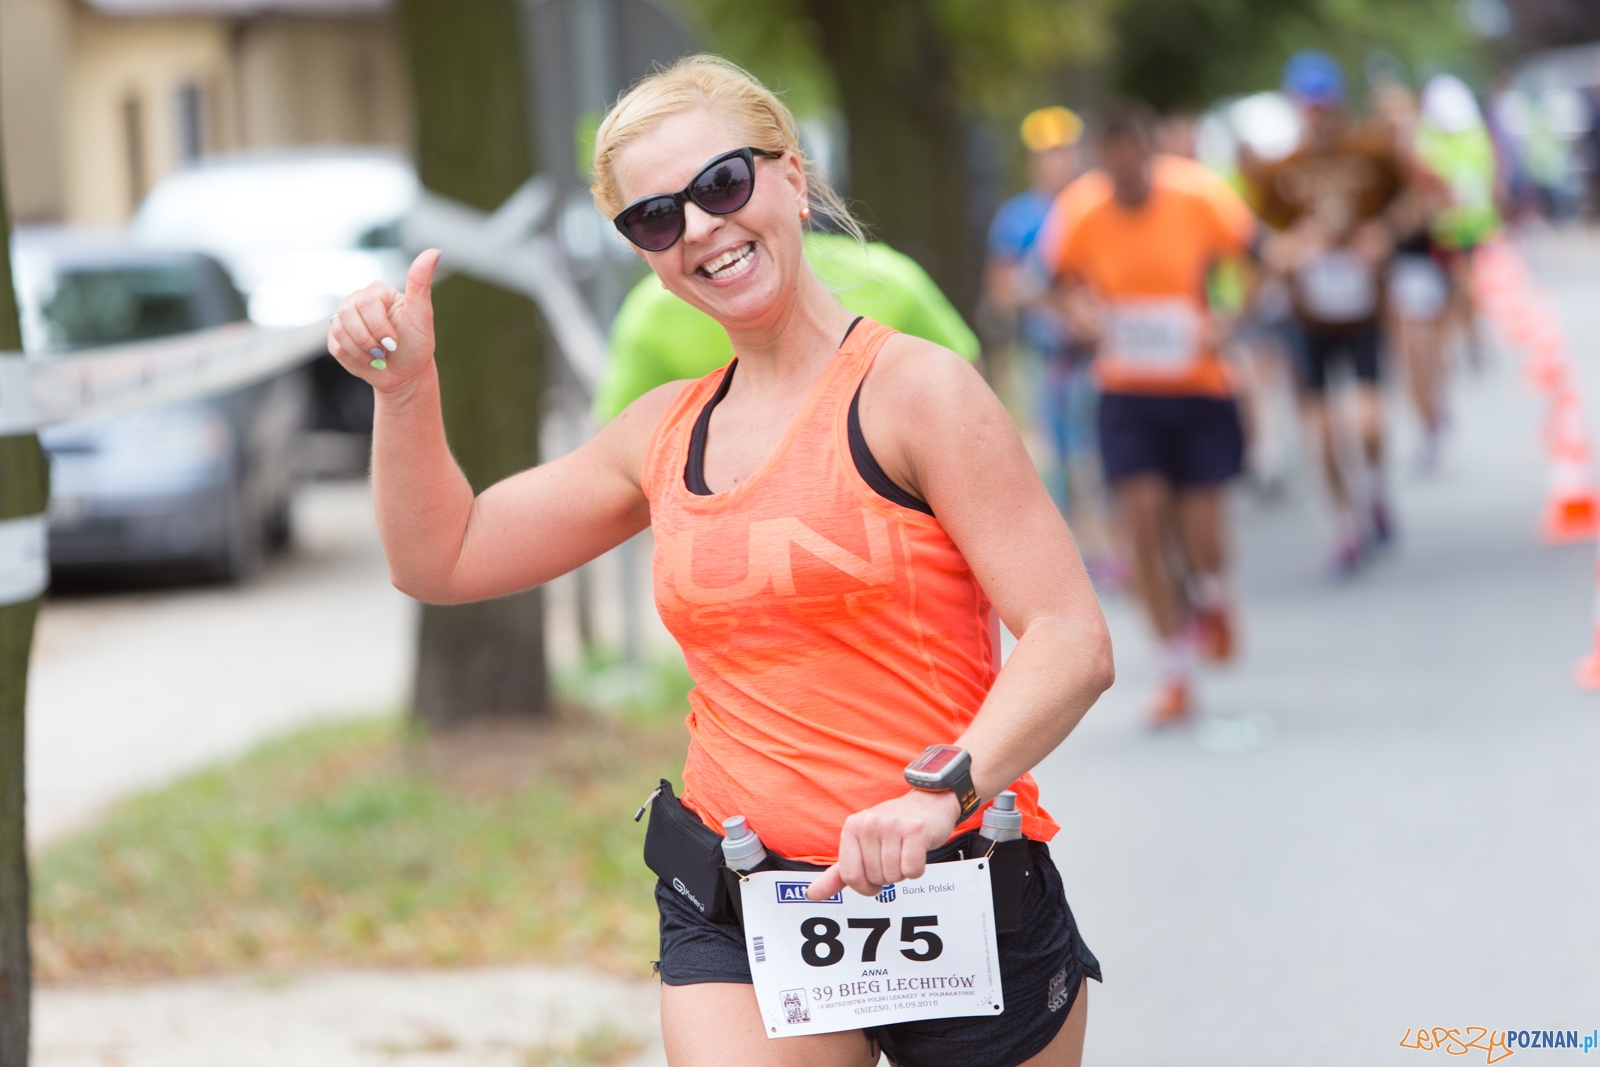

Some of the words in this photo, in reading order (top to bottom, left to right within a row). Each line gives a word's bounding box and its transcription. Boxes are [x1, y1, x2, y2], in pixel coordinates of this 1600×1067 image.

[902, 885, 926, 895] Bank
[928, 882, 955, 893] Polski
[800, 915, 943, 967] 875
[861, 968, 889, 977] ANNA
[812, 985, 833, 1002] 39
[838, 980, 881, 998] BIEG
[886, 973, 976, 992] LECHITÓW
[867, 995, 889, 1003] POLSKI
[889, 992, 919, 1001] LEKARZY
[893, 999, 939, 1010] 18.09.2016
